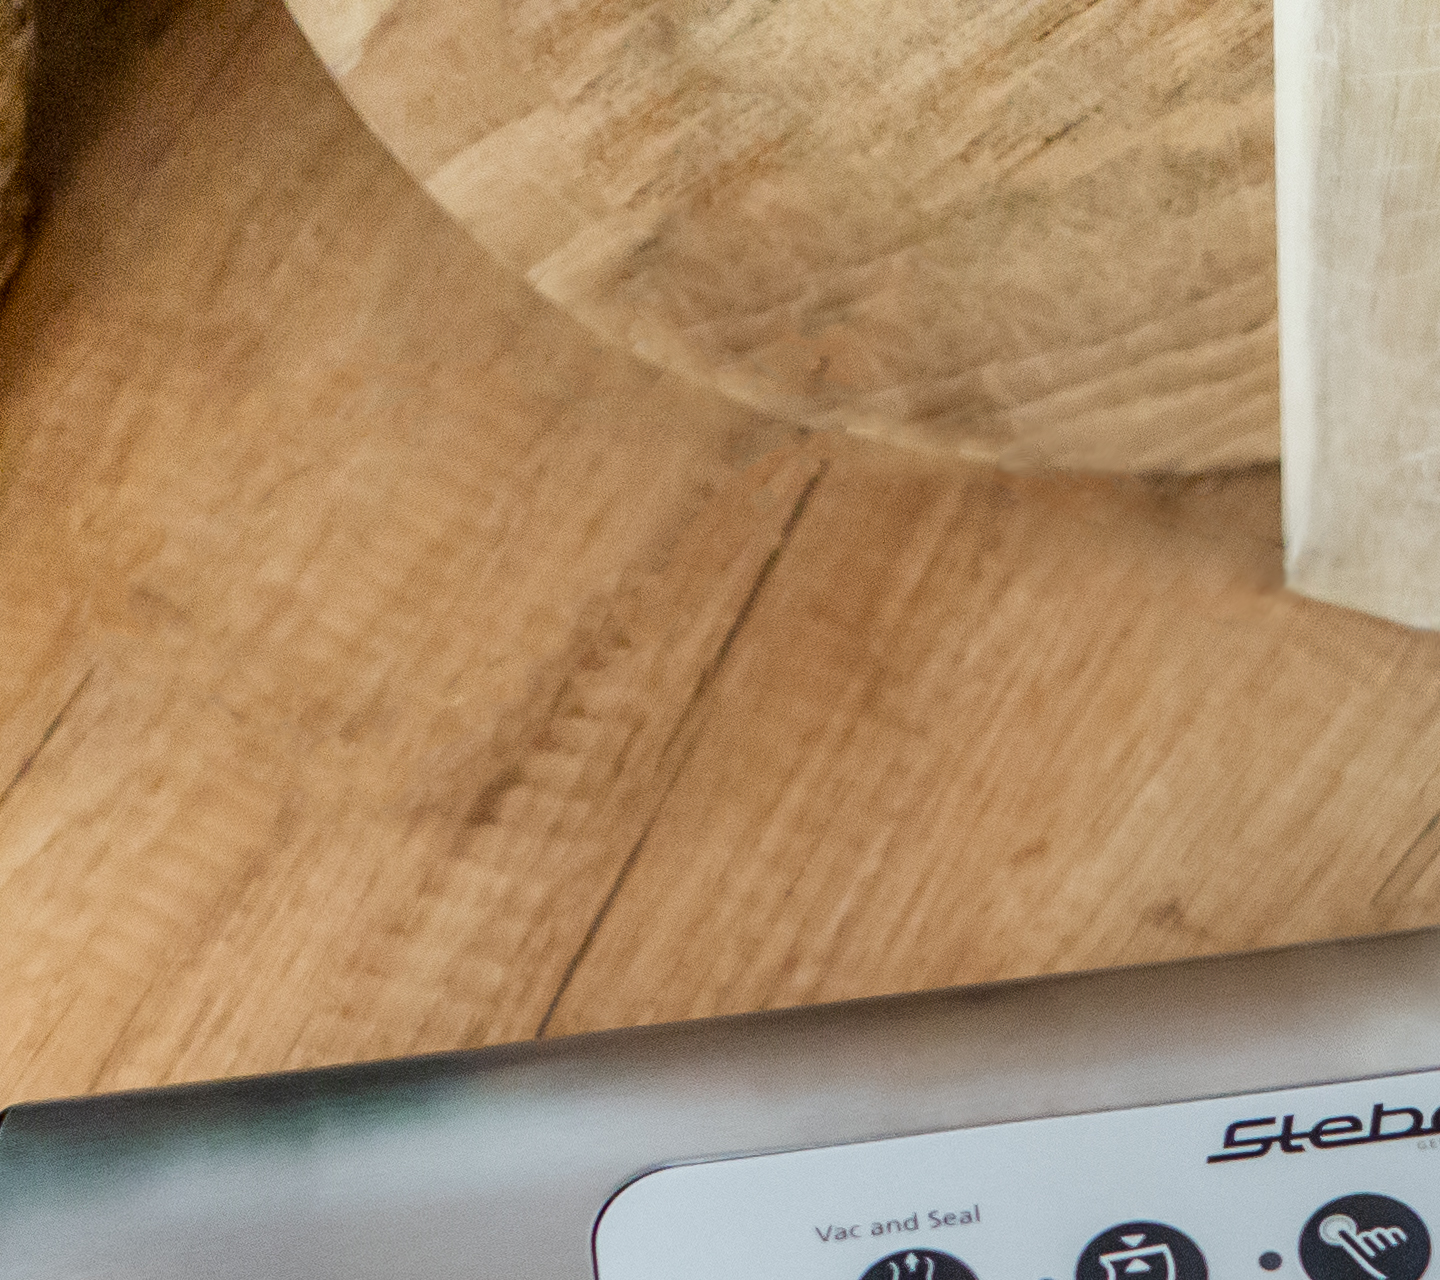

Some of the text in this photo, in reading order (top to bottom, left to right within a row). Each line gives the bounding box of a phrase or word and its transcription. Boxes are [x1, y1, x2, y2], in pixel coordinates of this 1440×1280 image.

[815, 1204, 981, 1242] Vac and Seal
